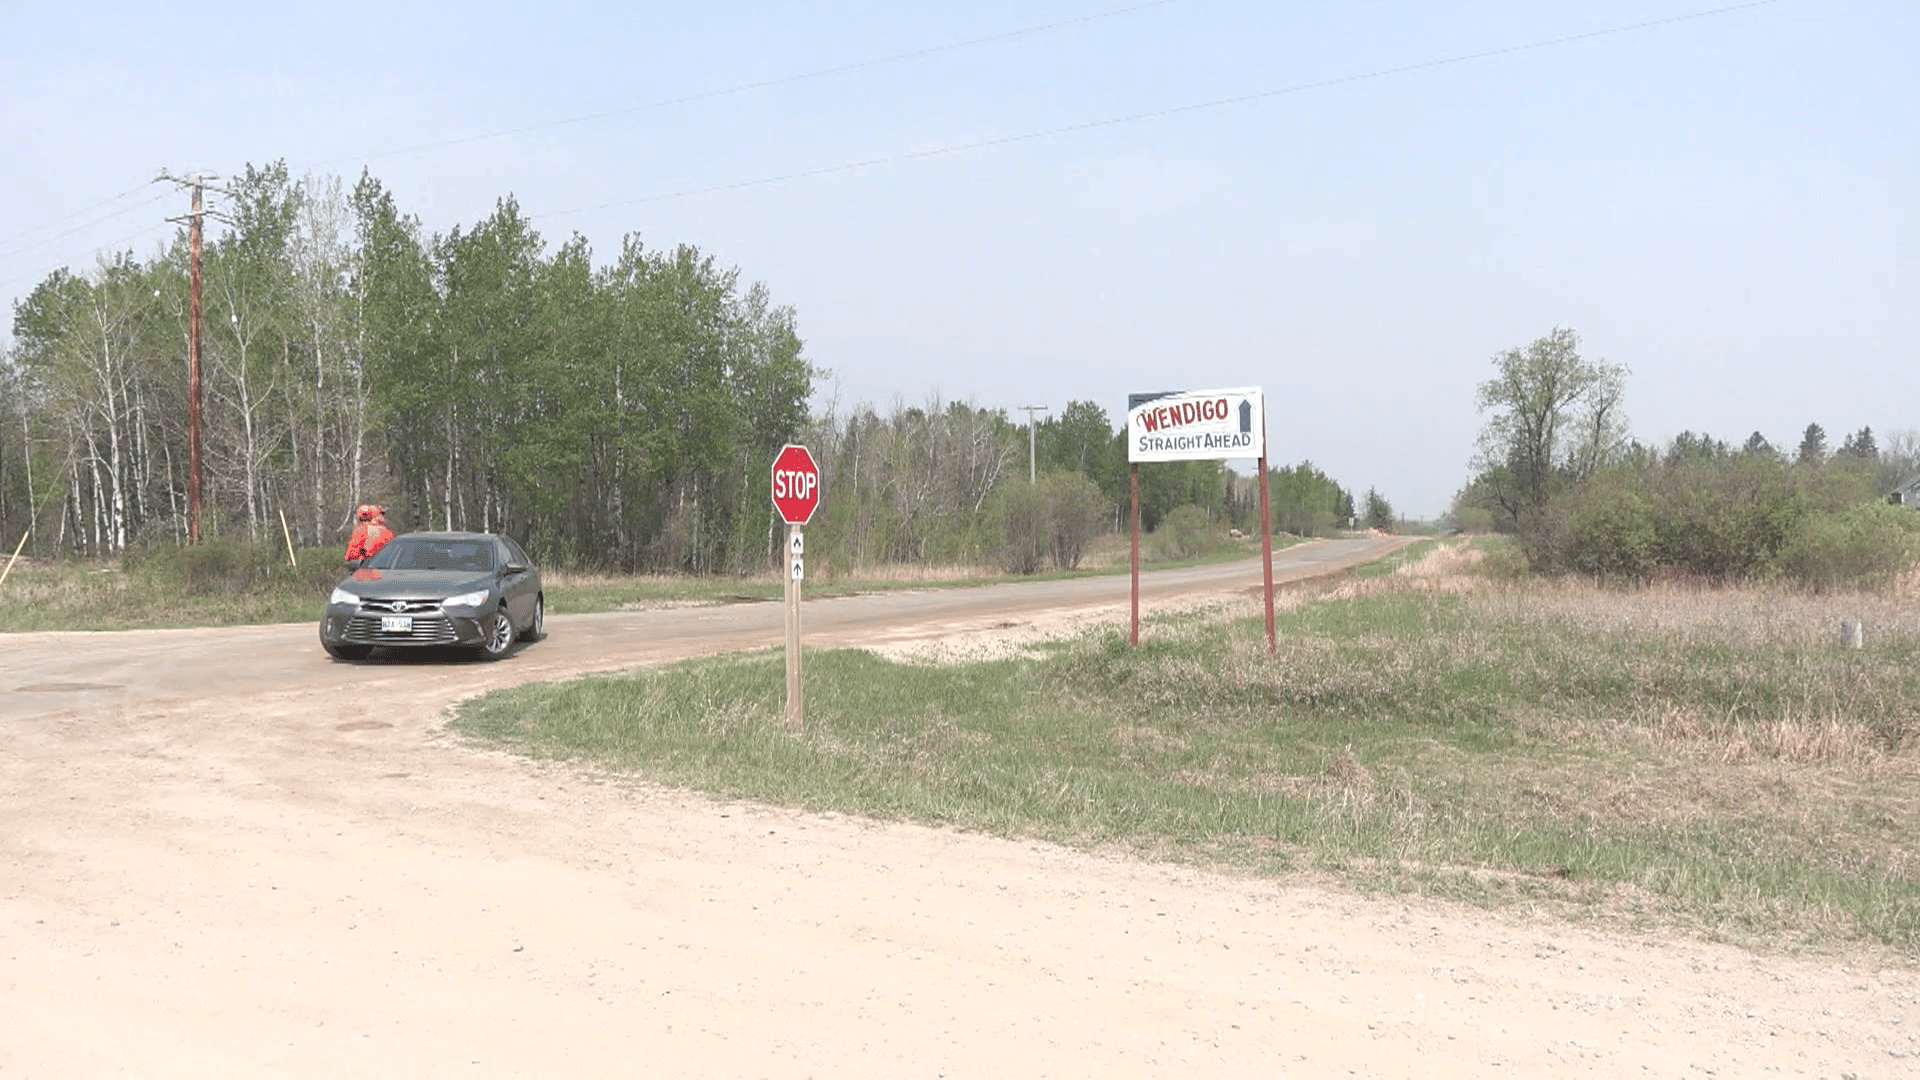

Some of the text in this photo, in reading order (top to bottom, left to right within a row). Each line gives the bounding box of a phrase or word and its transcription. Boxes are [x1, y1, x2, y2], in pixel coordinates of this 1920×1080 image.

[1136, 399, 1228, 432] WENDIGO
[1139, 433, 1251, 451] STRAIGHT AHEAD
[775, 469, 816, 500] STOP
